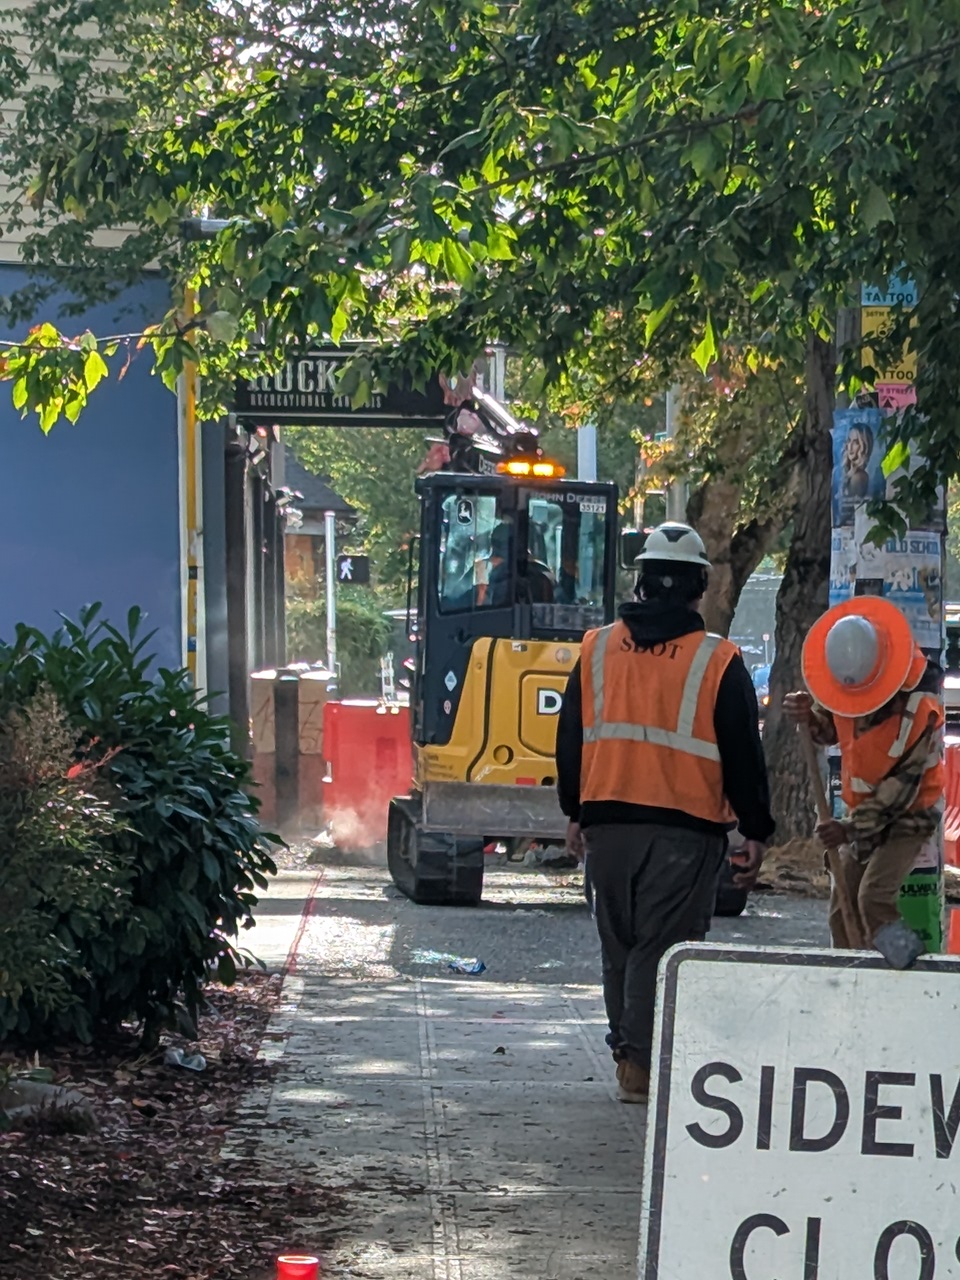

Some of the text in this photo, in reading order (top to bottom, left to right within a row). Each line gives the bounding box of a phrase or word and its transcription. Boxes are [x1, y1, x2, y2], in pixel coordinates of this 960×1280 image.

[865, 293, 913, 303] TATOO
[876, 371, 914, 380] TTOO
[250, 393, 382, 408] RECREATIONAL CANIS
